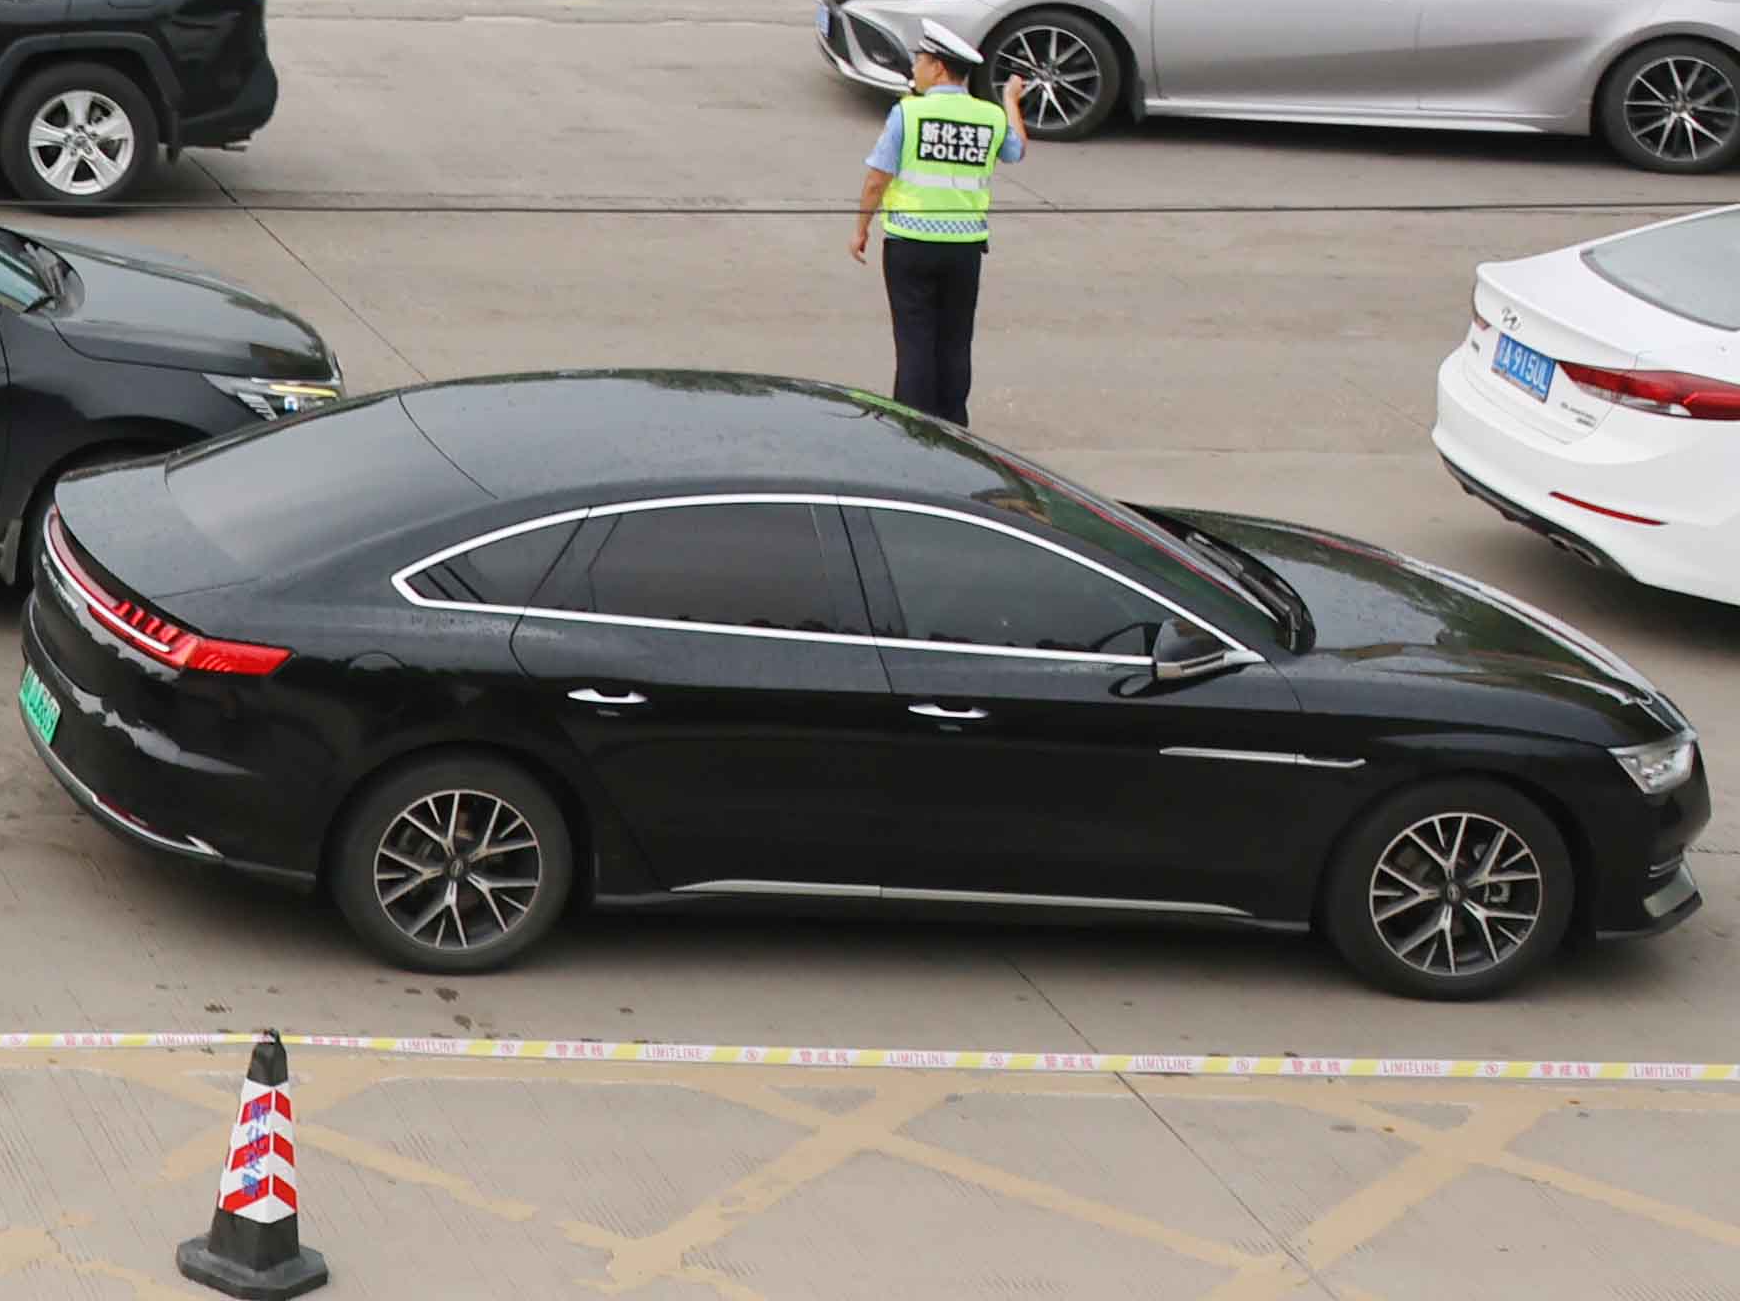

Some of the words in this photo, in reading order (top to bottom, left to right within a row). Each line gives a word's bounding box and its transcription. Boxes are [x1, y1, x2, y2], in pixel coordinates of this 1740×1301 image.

[921, 121, 992, 148] 新化交警
[920, 142, 988, 163] POLICE
[401, 1040, 459, 1053] LIMITLINE
[556, 1044, 605, 1057] 警戒线
[644, 1047, 703, 1060] LIMITLINE
[800, 1051, 849, 1064] 警戒线
[889, 1053, 947, 1066] LIMITLINE
[1045, 1056, 1094, 1069] 警戒线
[1135, 1058, 1192, 1071] LIMITLINE
[1292, 1061, 1341, 1074] 警戒线
[1382, 1062, 1442, 1075] LIMITLINE
[1540, 1064, 1590, 1077] 警戒线
[1634, 1065, 1692, 1078] LIMITLINE
